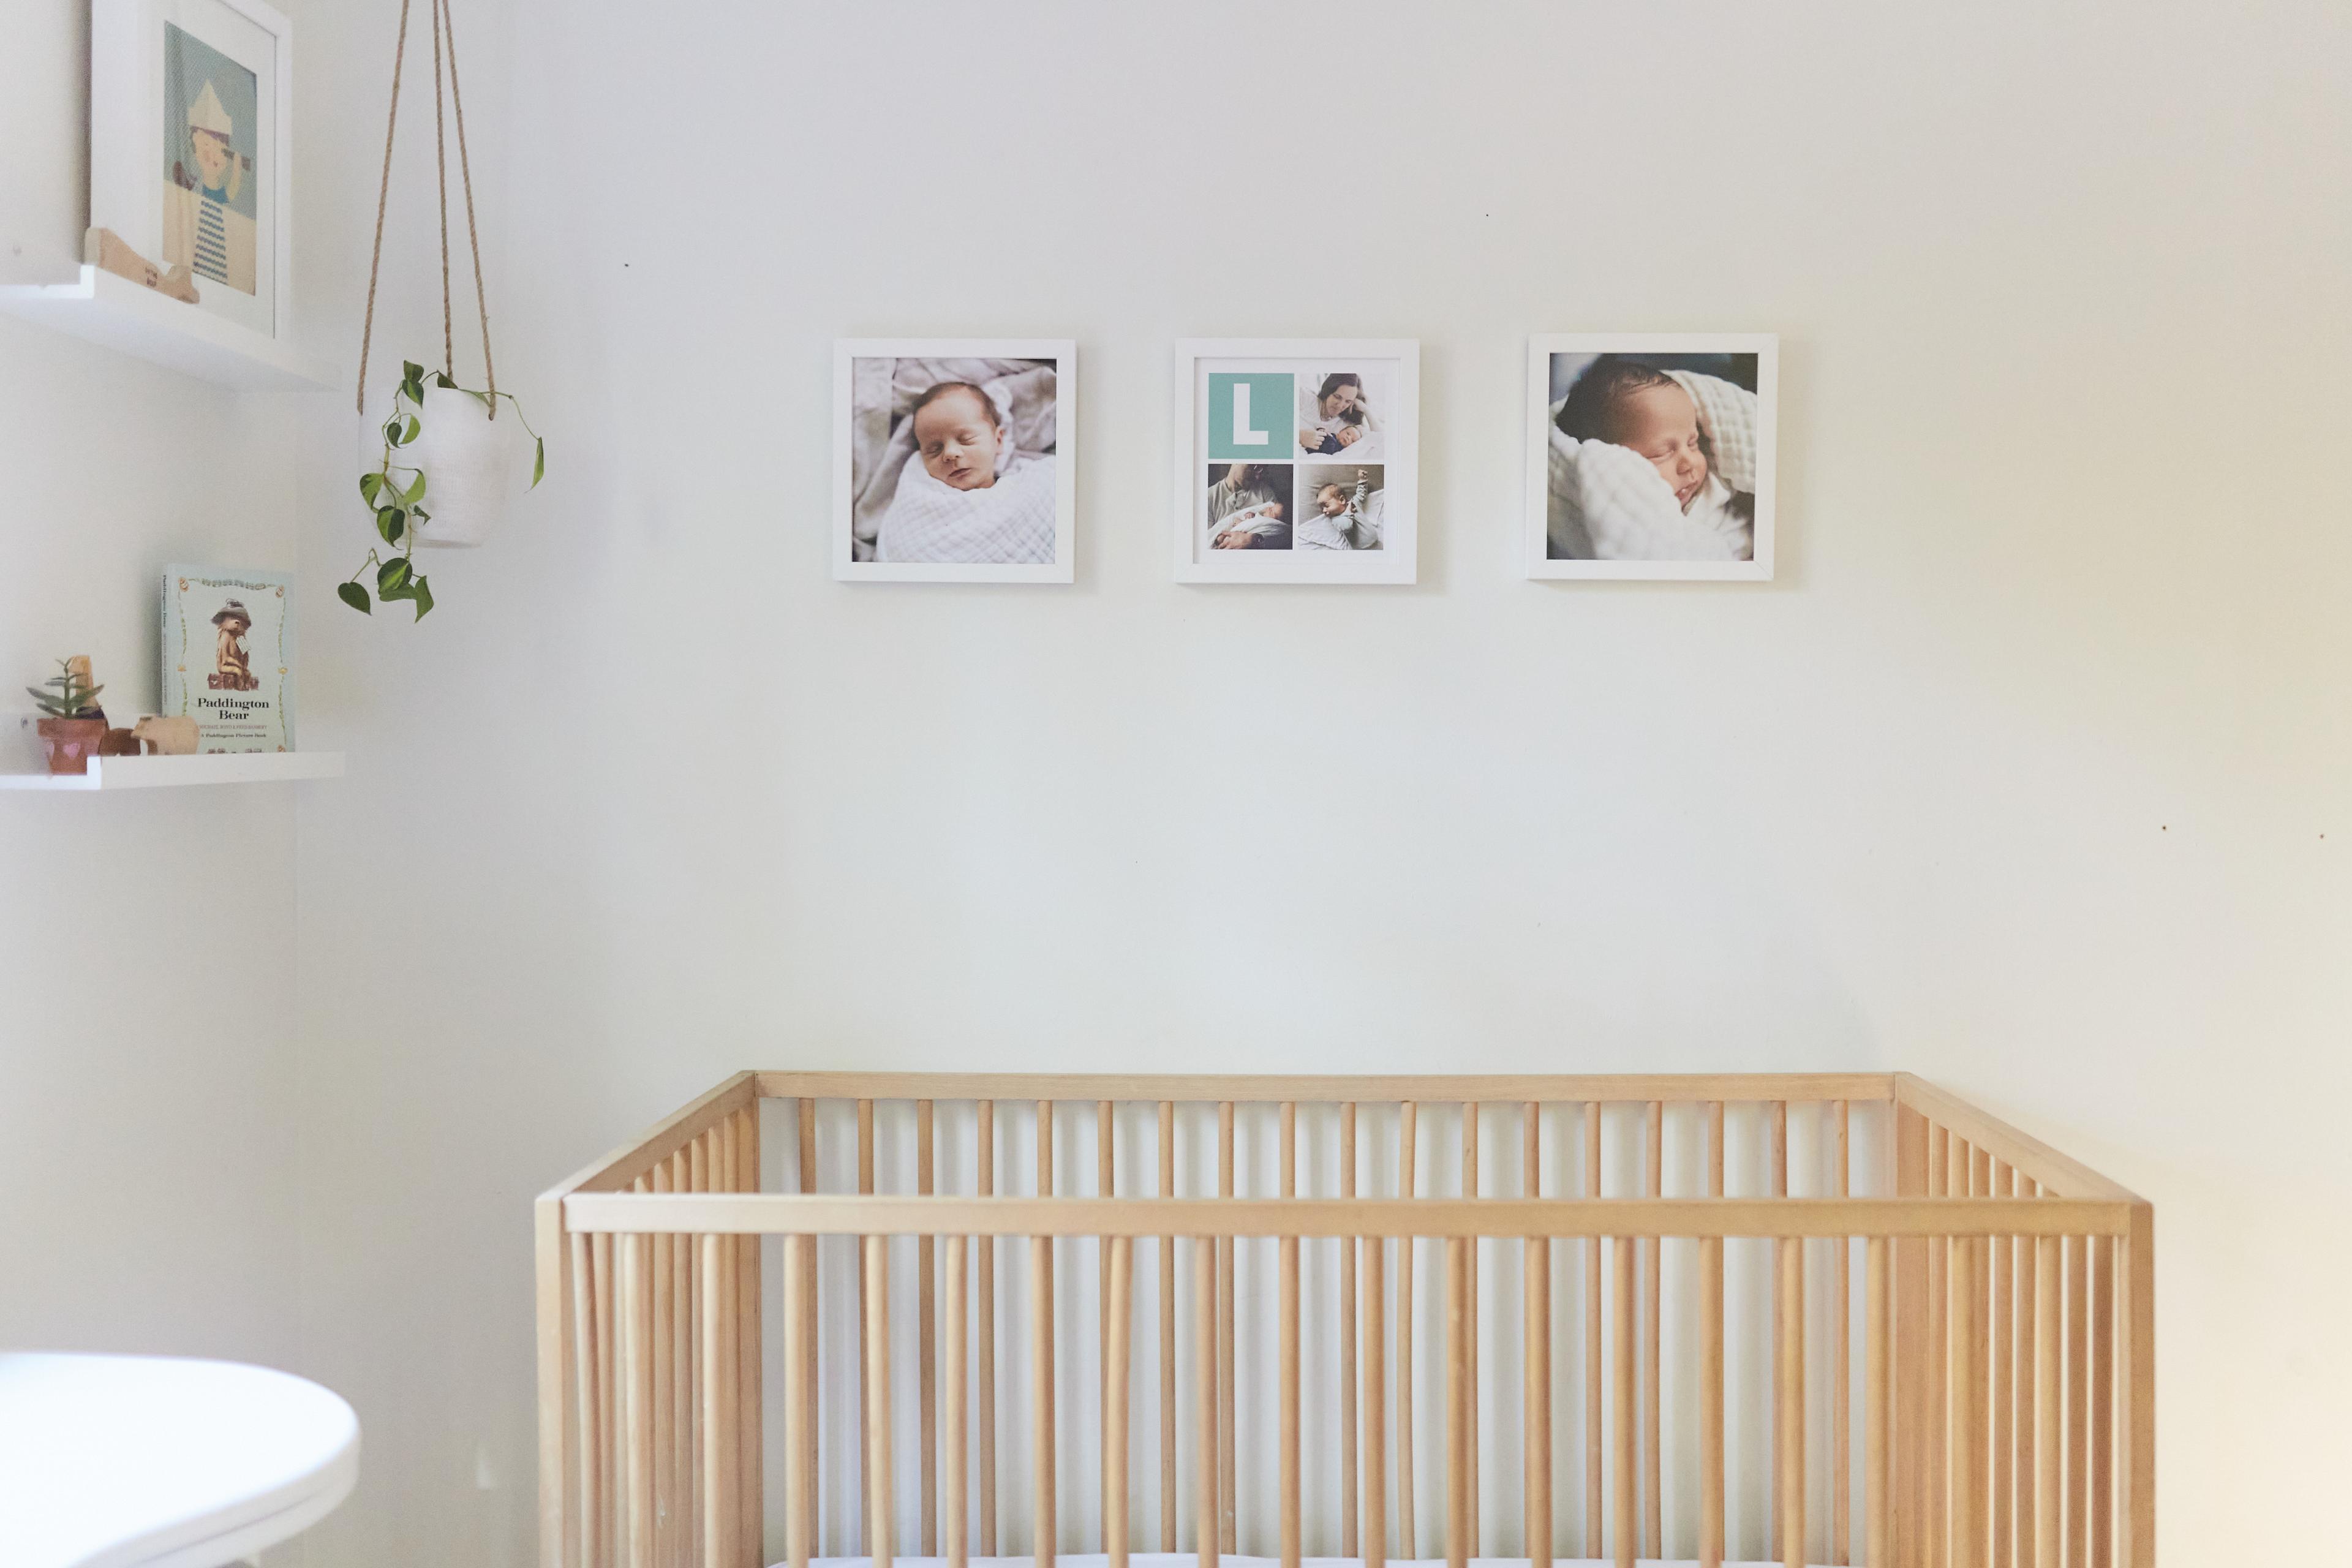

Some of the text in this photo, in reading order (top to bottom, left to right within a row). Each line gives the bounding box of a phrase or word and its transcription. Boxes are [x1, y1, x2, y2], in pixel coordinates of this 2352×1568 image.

[1233, 383, 1268, 445] L
[198, 698, 270, 710] Paddington
[219, 710, 249, 720] Bear
